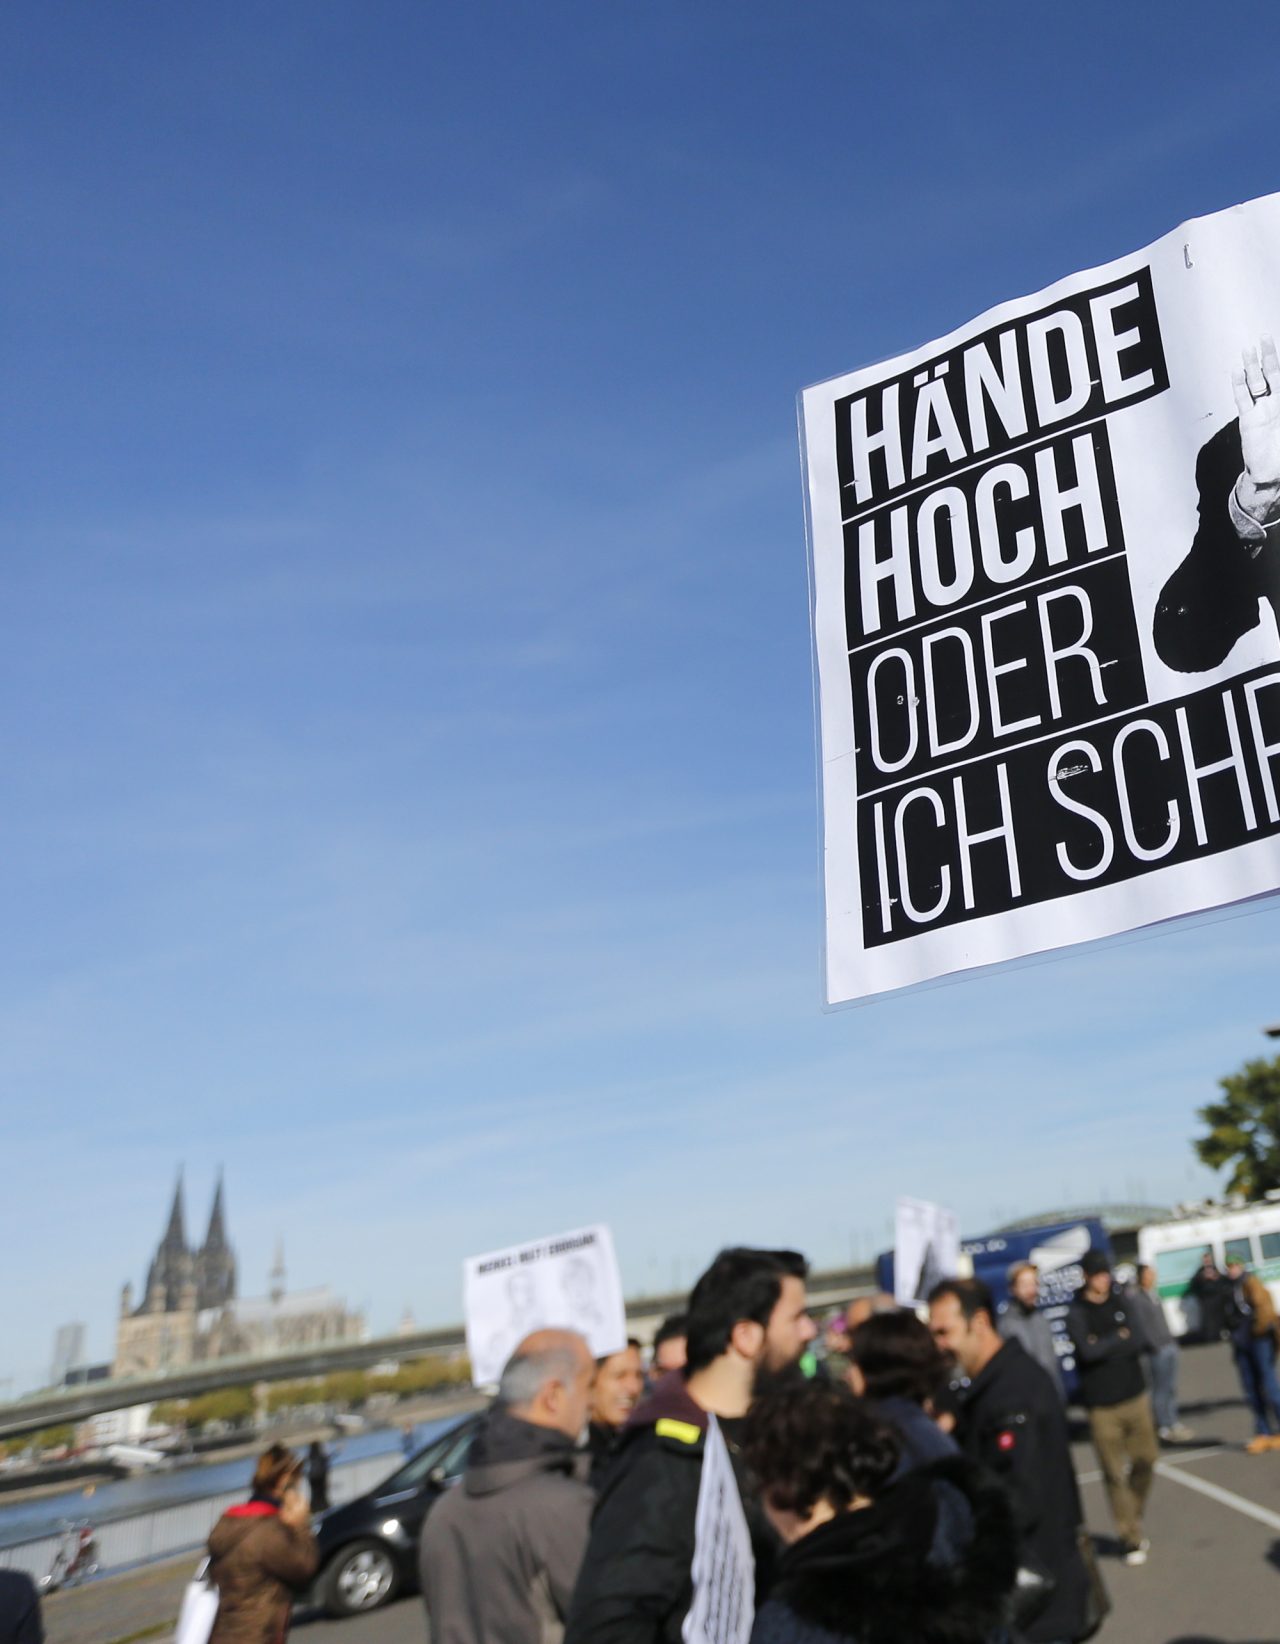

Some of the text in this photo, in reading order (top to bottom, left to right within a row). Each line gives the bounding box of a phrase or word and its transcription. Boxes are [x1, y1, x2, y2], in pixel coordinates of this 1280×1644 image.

[849, 282, 1154, 505] HÄNDE
[857, 433, 1108, 636] HOCH
[867, 585, 1107, 773] ODER
[873, 763, 1021, 933] ICH
